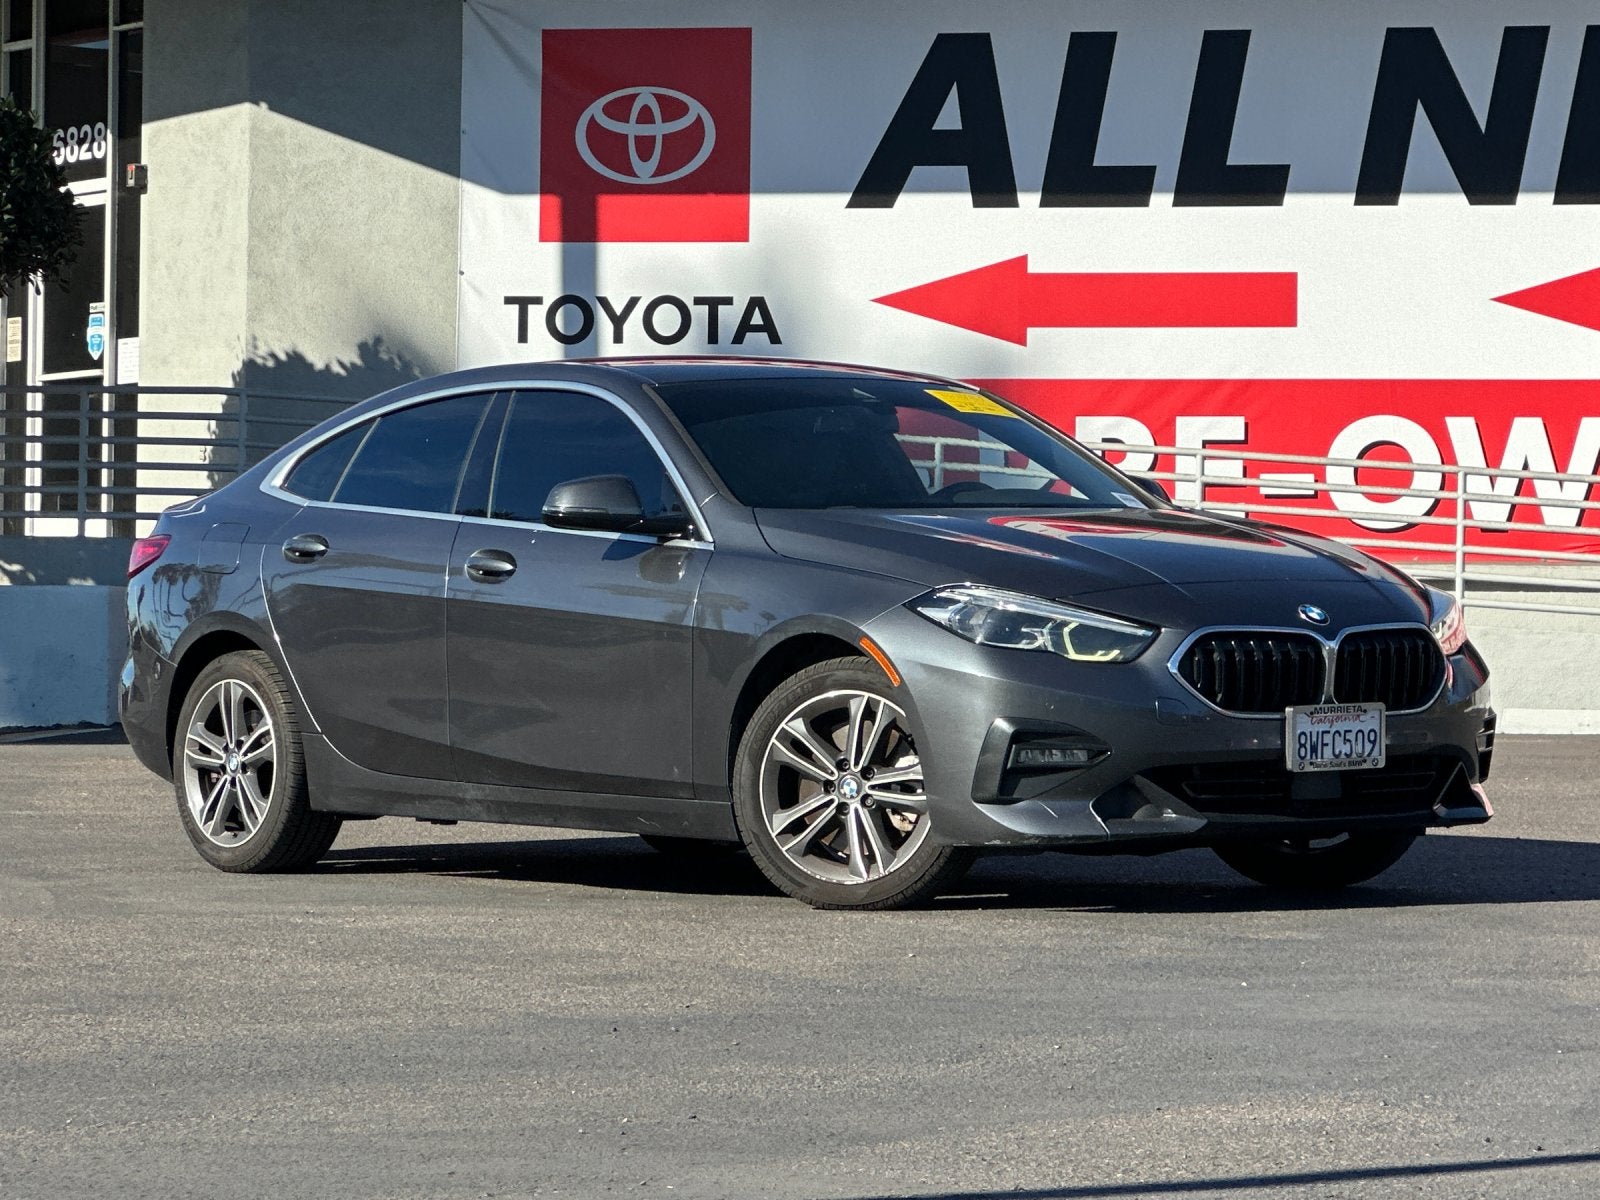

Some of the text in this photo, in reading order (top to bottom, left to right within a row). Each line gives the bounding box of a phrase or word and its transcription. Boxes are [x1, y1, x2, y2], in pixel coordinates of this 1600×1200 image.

[845, 29, 1290, 208] ALL
[52, 121, 107, 165] 6828
[503, 294, 783, 346] TOYOTA
[1311, 714, 1366, 728] California
[1313, 705, 1363, 715] MURRIETA
[1297, 728, 1378, 761] 8WFC509
